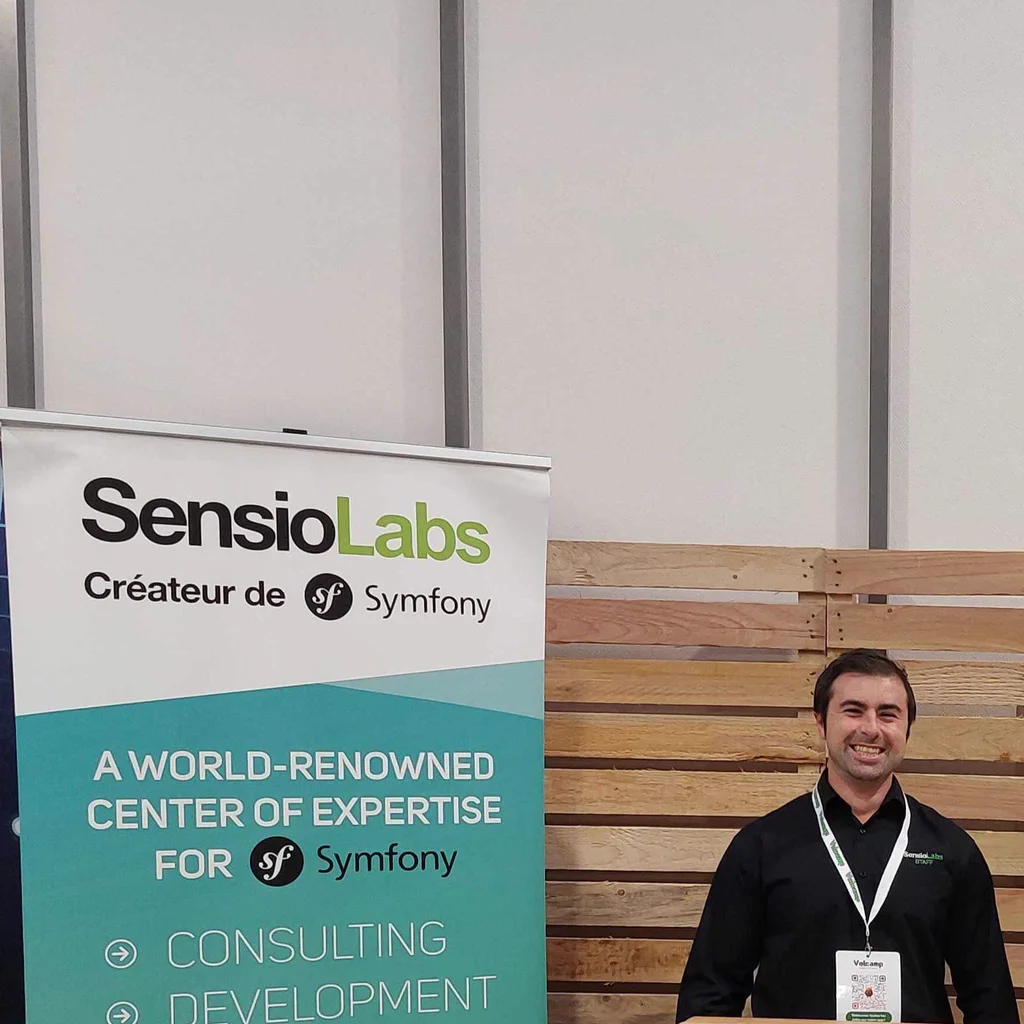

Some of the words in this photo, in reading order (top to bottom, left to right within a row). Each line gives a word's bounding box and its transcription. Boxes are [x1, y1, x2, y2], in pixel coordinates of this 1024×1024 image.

[82, 477, 490, 564] SensioLabs
[84, 572, 235, 604] Créateur
[245, 581, 285, 607] de
[365, 584, 492, 623] Symfony
[93, 751, 122, 780] A
[128, 751, 493, 780] WORLD-RENOWNED
[88, 799, 244, 829] CENTER
[255, 798, 302, 826] OF
[313, 796, 501, 826] EXPERTISE
[156, 849, 232, 879] FOR
[318, 843, 457, 880] Symfony
[169, 922, 445, 967] CONSULTING
[853, 960, 884, 969] Volcamp
